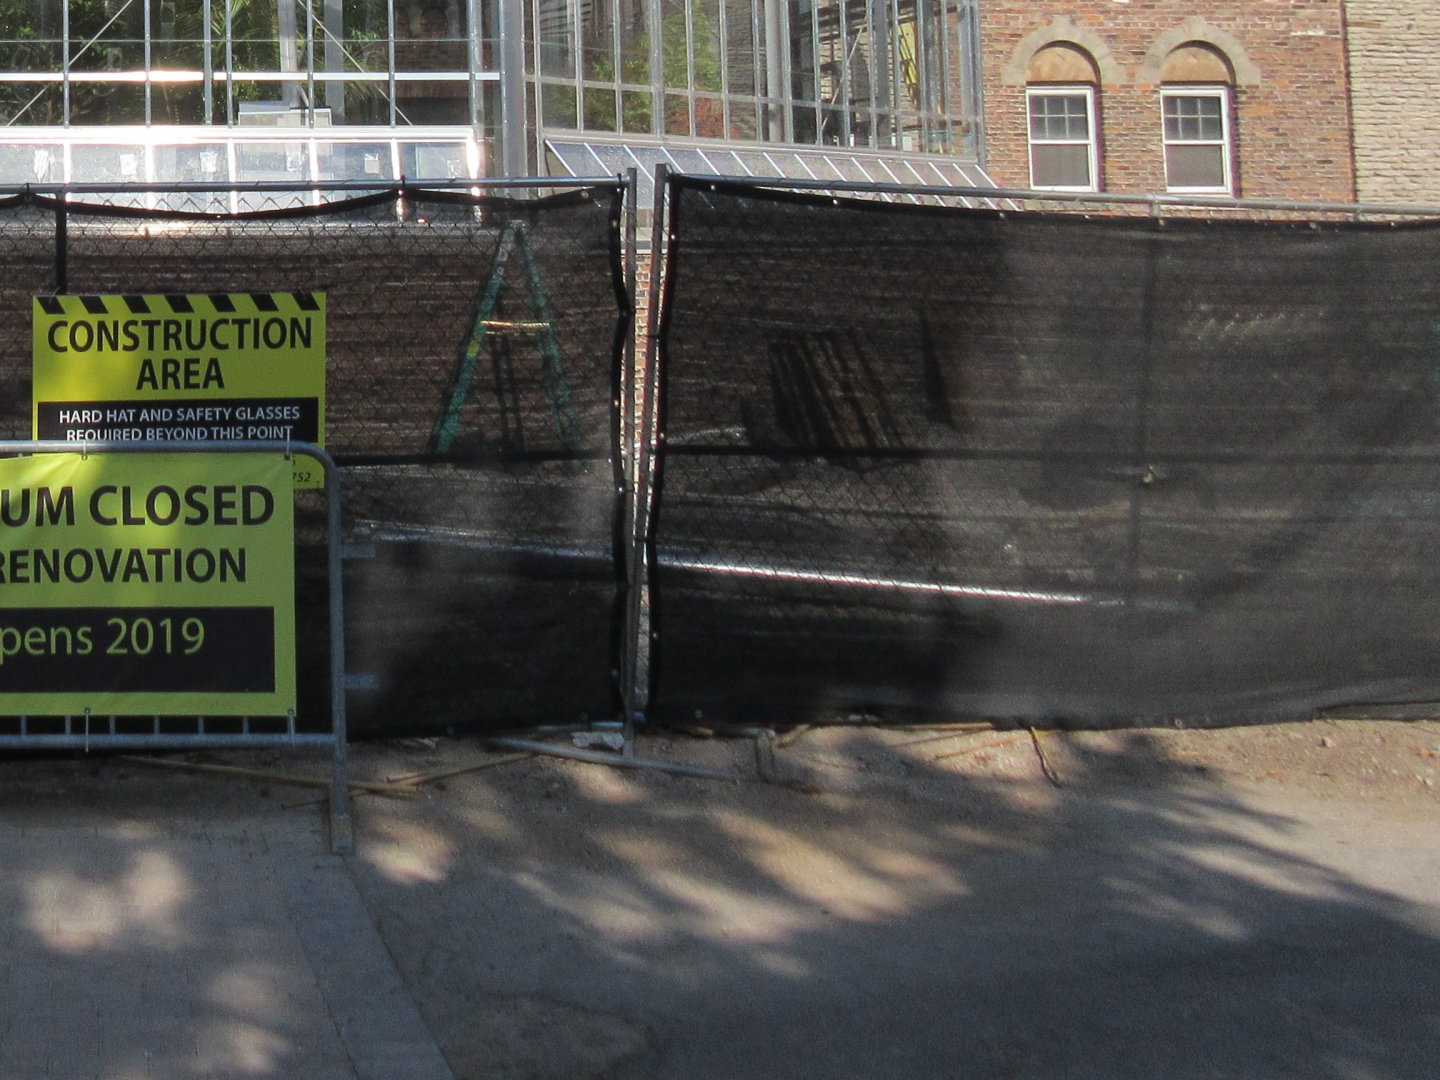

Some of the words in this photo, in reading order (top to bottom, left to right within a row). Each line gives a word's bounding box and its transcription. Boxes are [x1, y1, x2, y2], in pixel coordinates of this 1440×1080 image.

[47, 316, 312, 353] CONSTRUCTION
[136, 357, 225, 391] AREA
[59, 409, 103, 424] HARD
[106, 408, 136, 423] HAT
[140, 408, 173, 422] AND
[177, 407, 232, 421] SAFETY
[235, 405, 301, 420] GLASSES
[66, 428, 143, 441] REQUIRED
[146, 427, 208, 440] BEYOND
[211, 426, 244, 440] THIS
[247, 425, 294, 439] POINT
[89, 484, 275, 527] CLOSED
[105, 617, 206, 656] 2019
